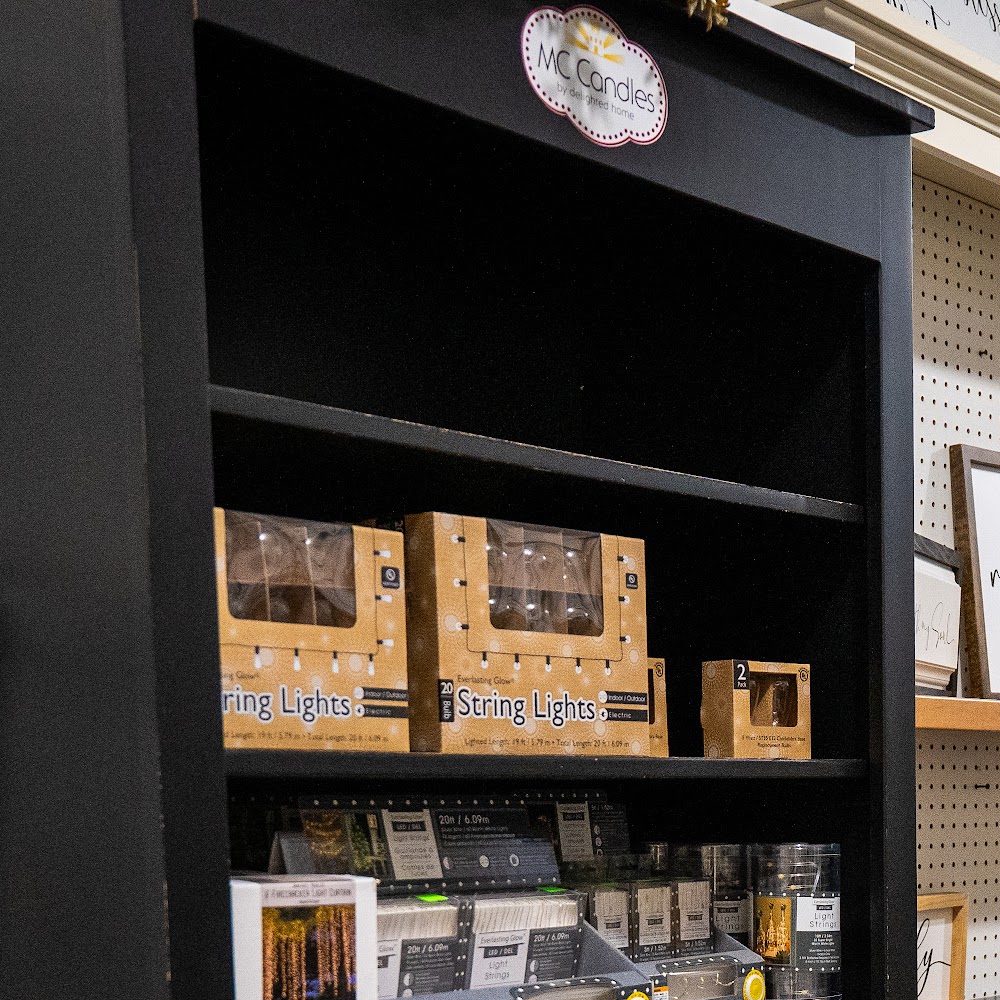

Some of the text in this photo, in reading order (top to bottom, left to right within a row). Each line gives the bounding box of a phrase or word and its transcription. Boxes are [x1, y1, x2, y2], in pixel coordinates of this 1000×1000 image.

[537, 41, 655, 113] MC Candles
[557, 83, 568, 95] by
[611, 104, 635, 120] home
[737, 664, 747, 680] 2
[457, 675, 492, 685] Everlasting
[441, 681, 453, 720] 20 Bulb
[627, 695, 646, 703] Outdoor
[224, 686, 351, 723] ring Lights
[458, 688, 595, 727] String Lights
[608, 711, 632, 719] Electric
[814, 912, 834, 921] Light
[809, 920, 838, 929] Strings
[480, 935, 510, 945] Everlasting
[551, 933, 570, 941] 6.09m
[408, 944, 449, 954] 20ft 6.09m
[489, 960, 508, 970] Light
[484, 971, 510, 981] Strings
